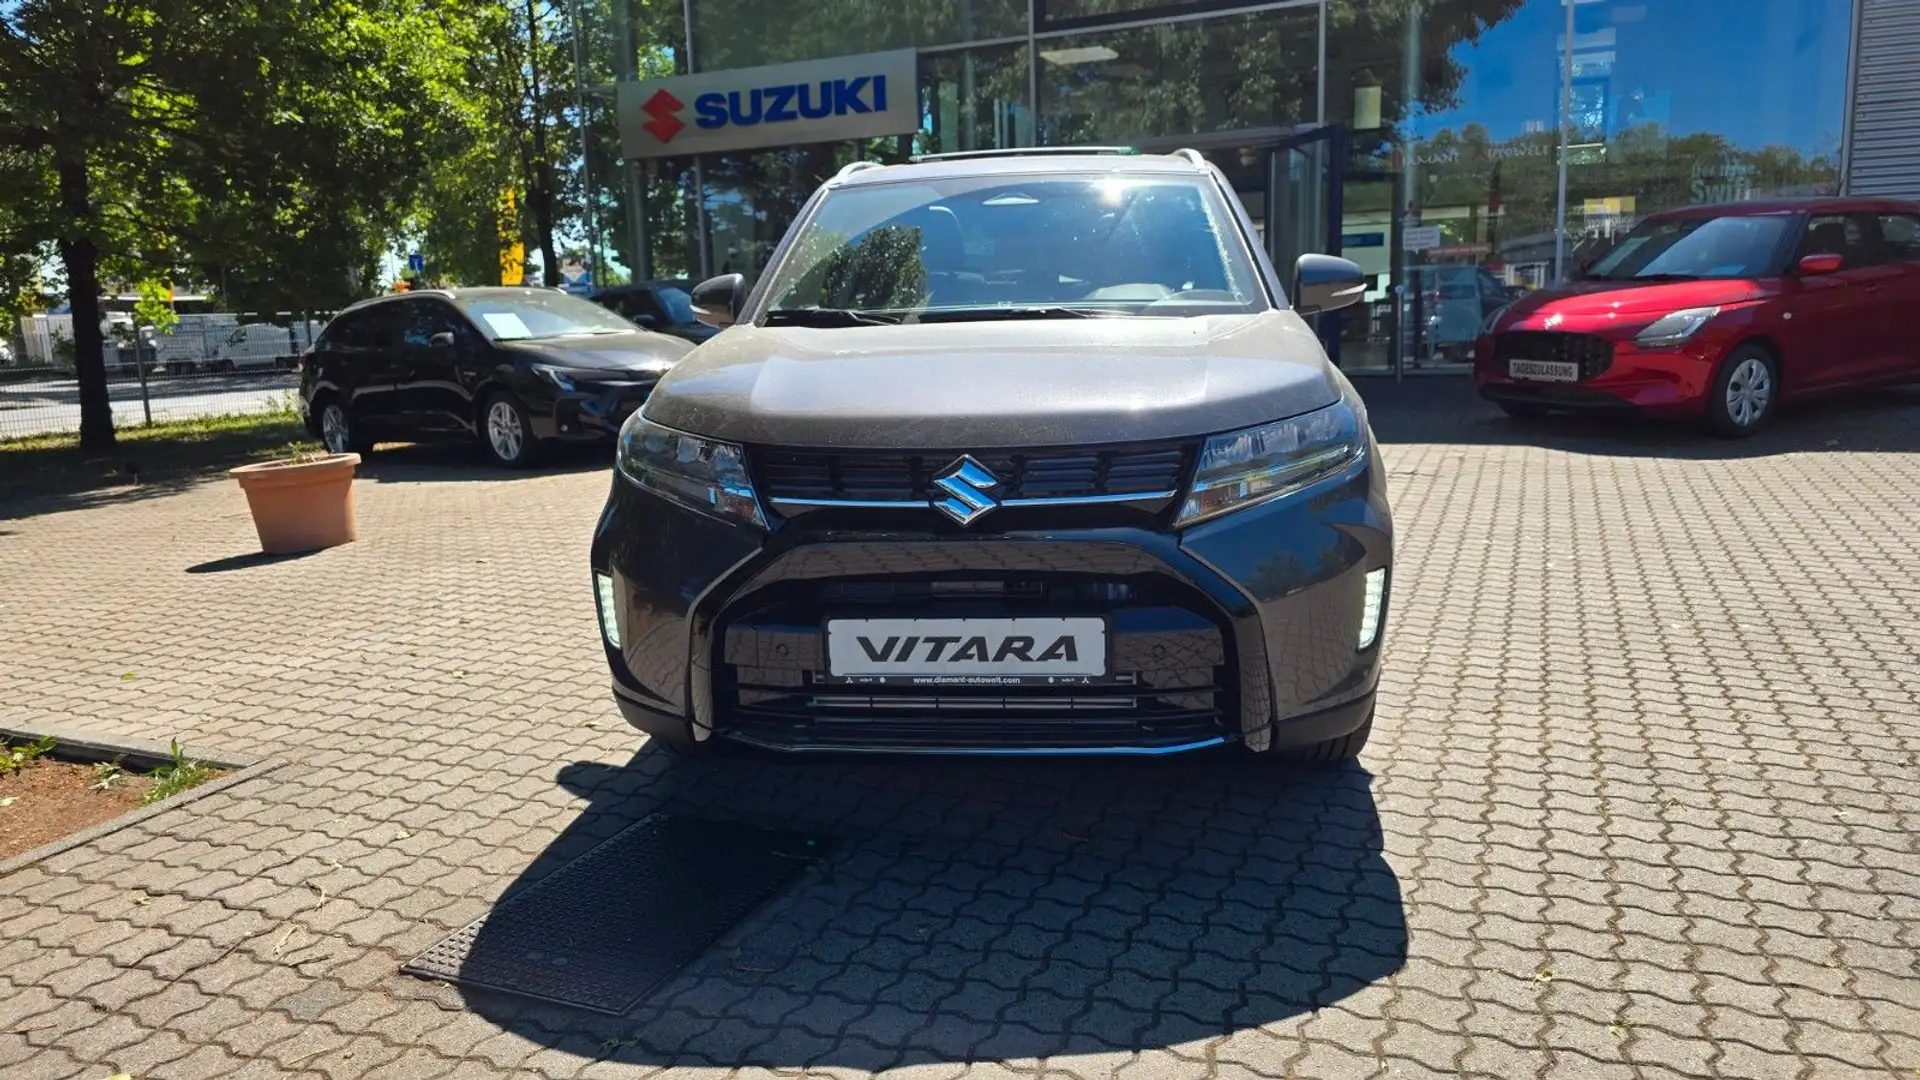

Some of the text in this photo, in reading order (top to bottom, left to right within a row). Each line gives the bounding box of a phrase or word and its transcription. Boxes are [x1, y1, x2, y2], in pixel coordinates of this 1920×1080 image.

[693, 75, 887, 130] SUZUKI
[1512, 362, 1573, 378] TAGESZULASSUNG
[856, 636, 1079, 662] VITARA
[913, 675, 1021, 685] www.diamant-autowelt.com
